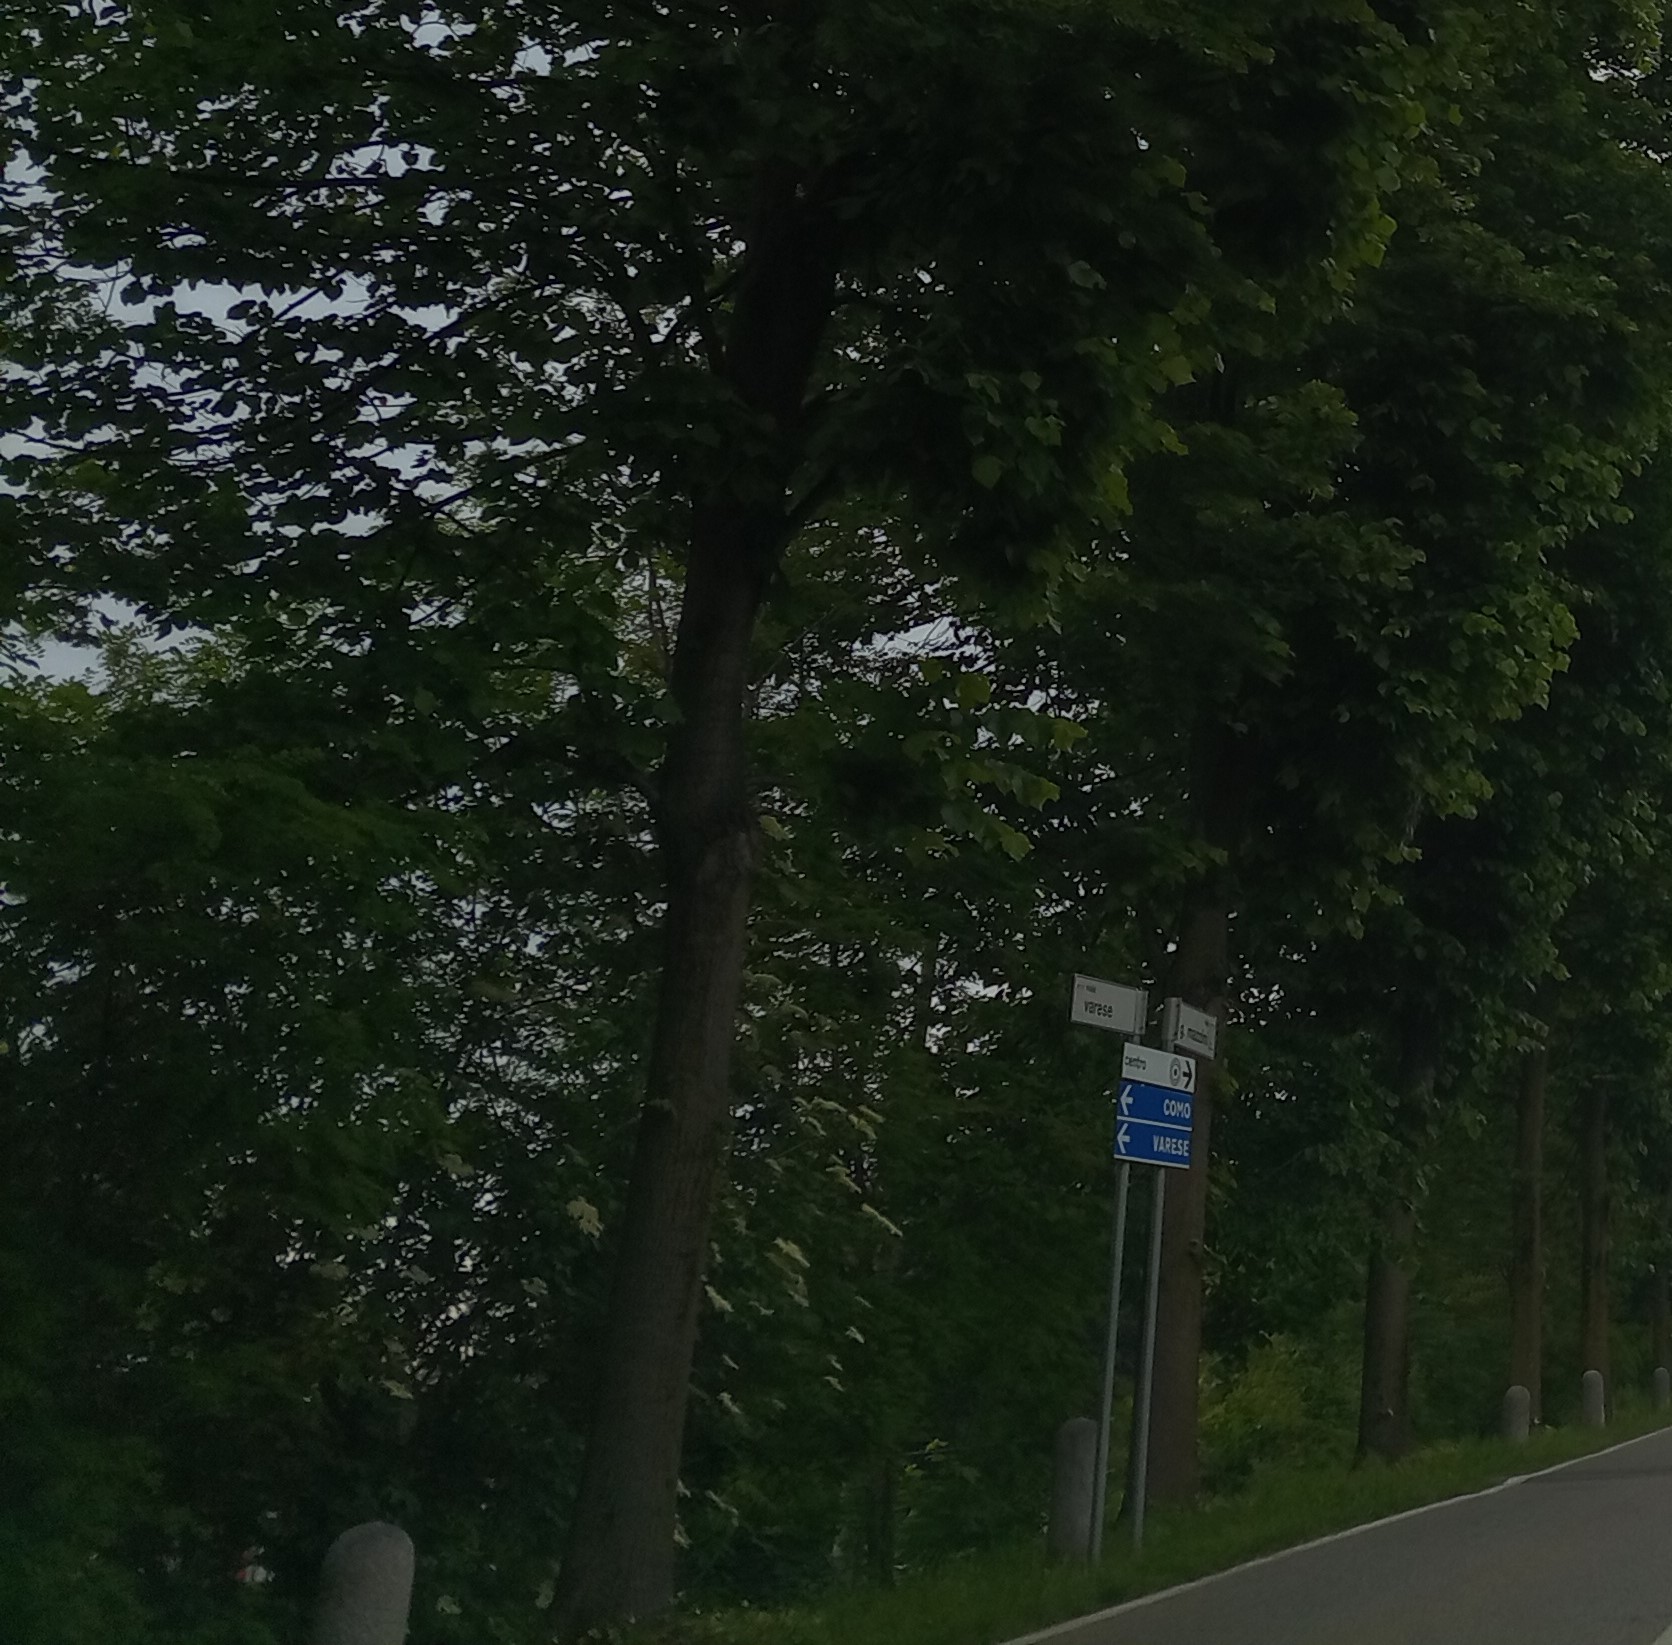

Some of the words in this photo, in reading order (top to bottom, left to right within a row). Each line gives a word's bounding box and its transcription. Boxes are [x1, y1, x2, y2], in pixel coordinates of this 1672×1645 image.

[1083, 1001, 1113, 1019] varese
[1163, 1098, 1191, 1119] COMO
[1152, 1134, 1190, 1157] VARESE
